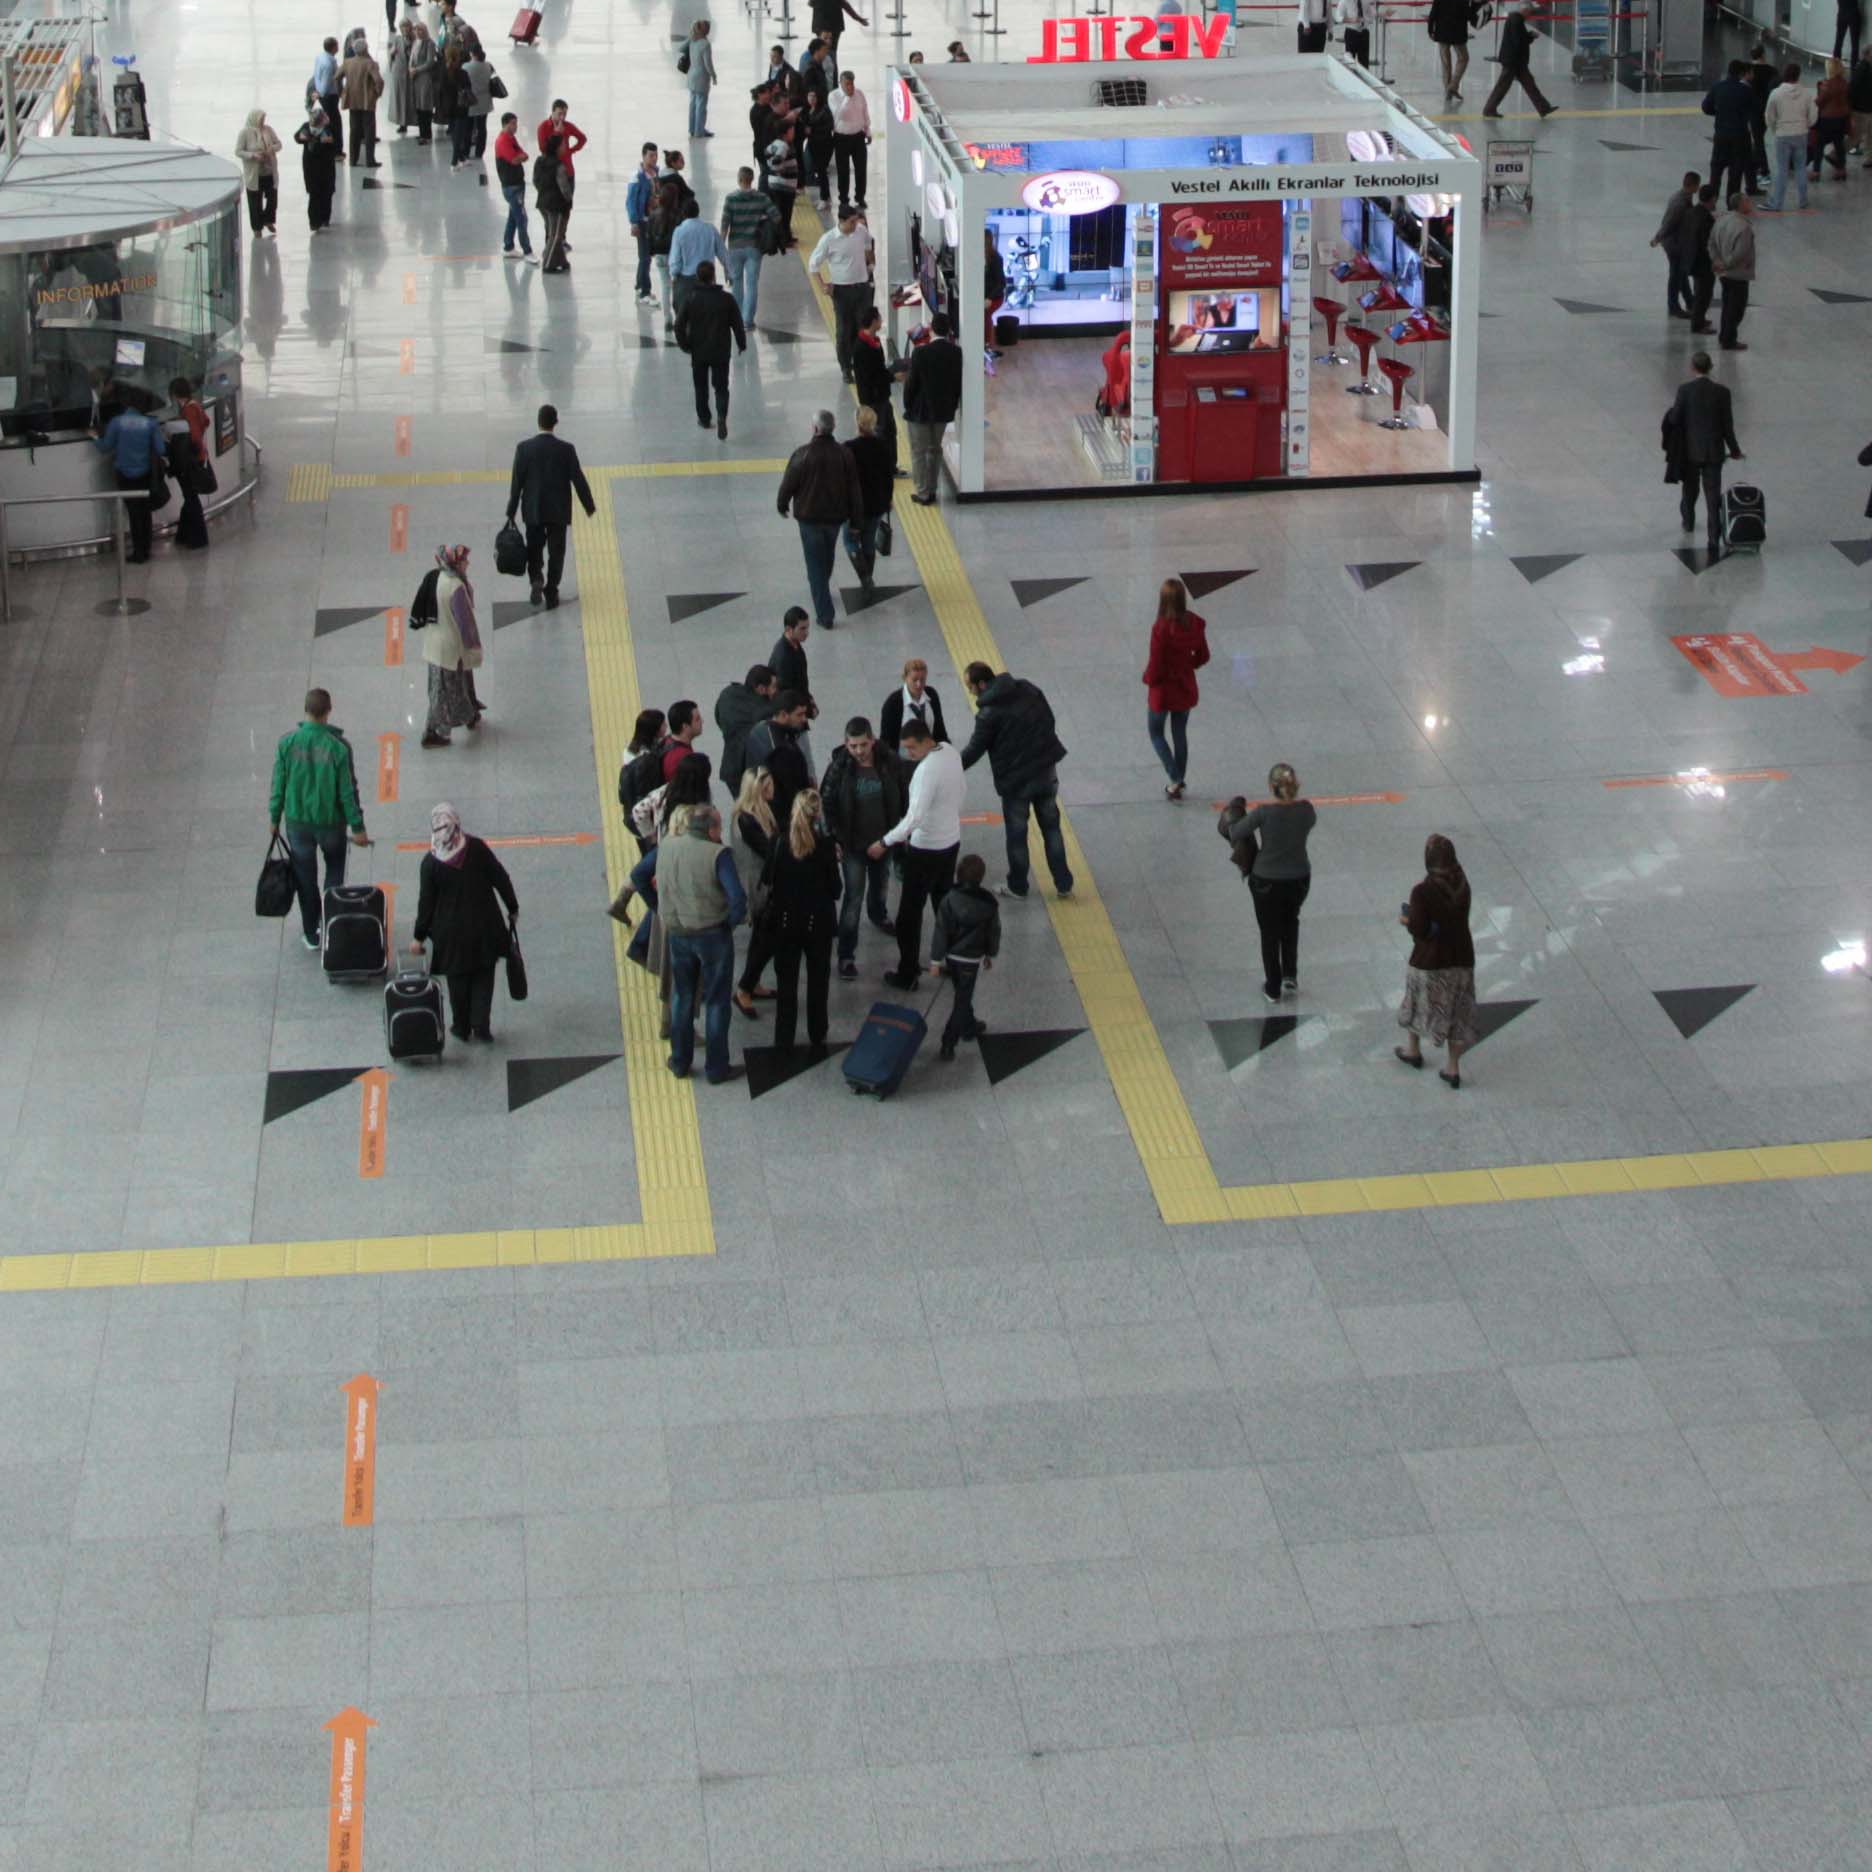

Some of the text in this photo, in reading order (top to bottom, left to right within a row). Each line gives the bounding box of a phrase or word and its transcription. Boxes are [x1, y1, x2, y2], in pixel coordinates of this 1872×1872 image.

[1171, 172, 1441, 194] Vestel Akıllı Ekranlar Teknolojisi
[36, 272, 158, 305] INFORMATION
[340, 1736, 357, 1783] Passenger
[338, 1782, 353, 1824] Transfer
